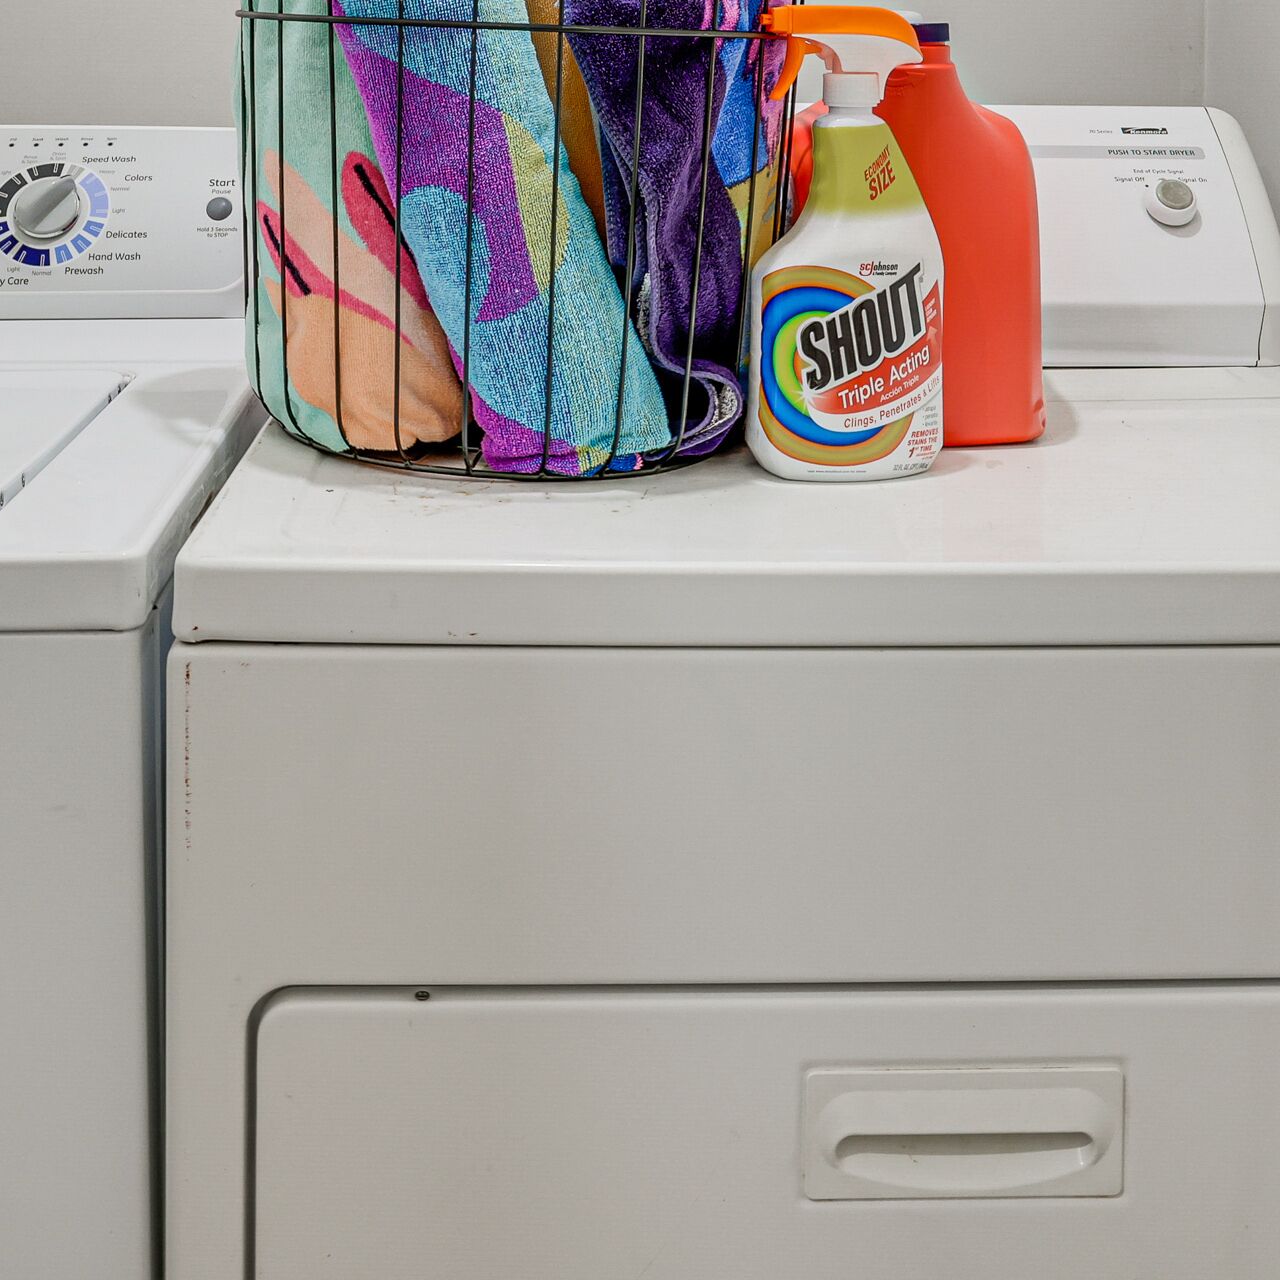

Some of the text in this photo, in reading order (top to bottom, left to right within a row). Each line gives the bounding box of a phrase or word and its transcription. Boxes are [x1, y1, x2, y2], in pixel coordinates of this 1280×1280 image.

[82, 156, 110, 164] Speed
[864, 144, 890, 182] ECONOMY
[125, 174, 153, 182] Colors
[869, 160, 896, 200] SIZE
[209, 179, 236, 187] Start
[106, 231, 148, 239] Delicates
[88, 252, 141, 261] Hand Wash
[65, 266, 104, 275] Prewash
[8, 277, 29, 286] Care
[801, 262, 922, 391] SHOUT
[838, 345, 930, 409] Triple Acting
[880, 375, 920, 402] Acción Triple
[844, 416, 877, 429] Clings,
[880, 394, 922, 421] Penetrates
[927, 376, 940, 393] Lifts
[911, 428, 939, 438] REMOVES
[907, 438, 928, 446] STAINS
